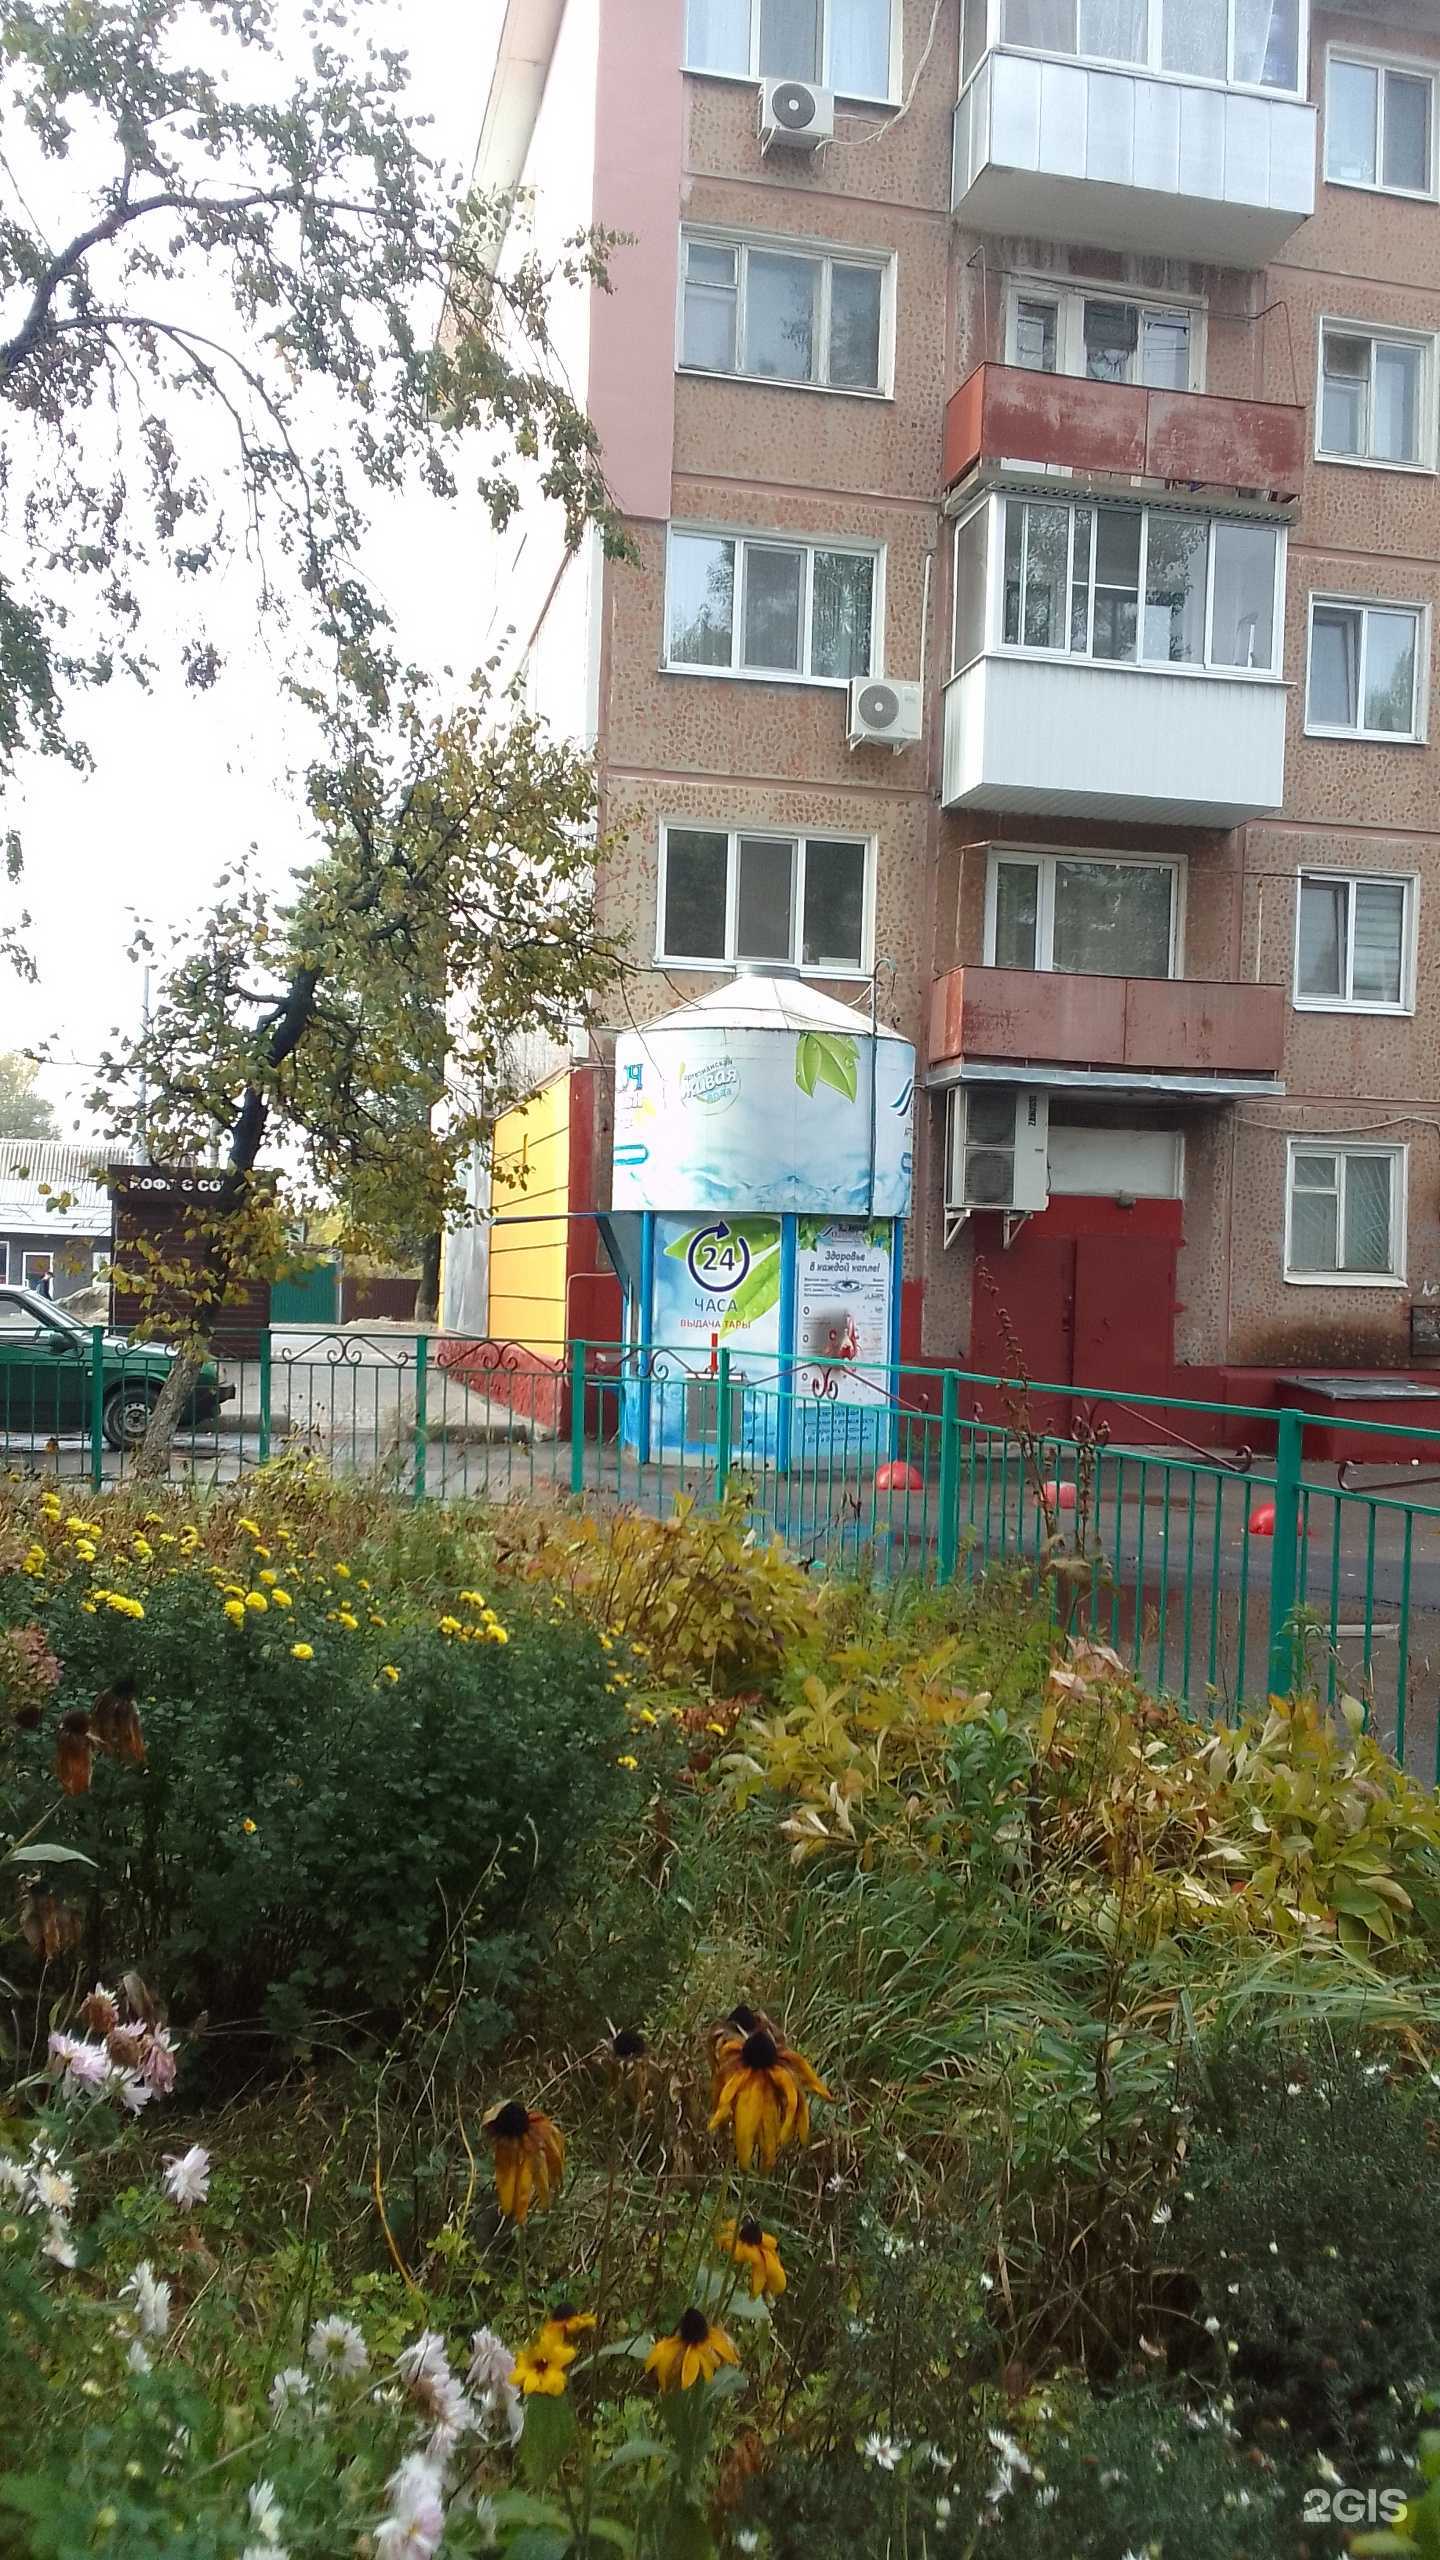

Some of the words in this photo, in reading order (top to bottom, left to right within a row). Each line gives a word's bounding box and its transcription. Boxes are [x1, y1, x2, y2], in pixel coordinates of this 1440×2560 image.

[703, 1247, 735, 1271] 24
[825, 1250, 866, 1263] Здоровье
[817, 1262, 850, 1272] каждой
[852, 1263, 881, 1273] капле!
[694, 1298, 738, 1312] ЧАСА
[724, 1319, 751, 1329] ТАРЫ
